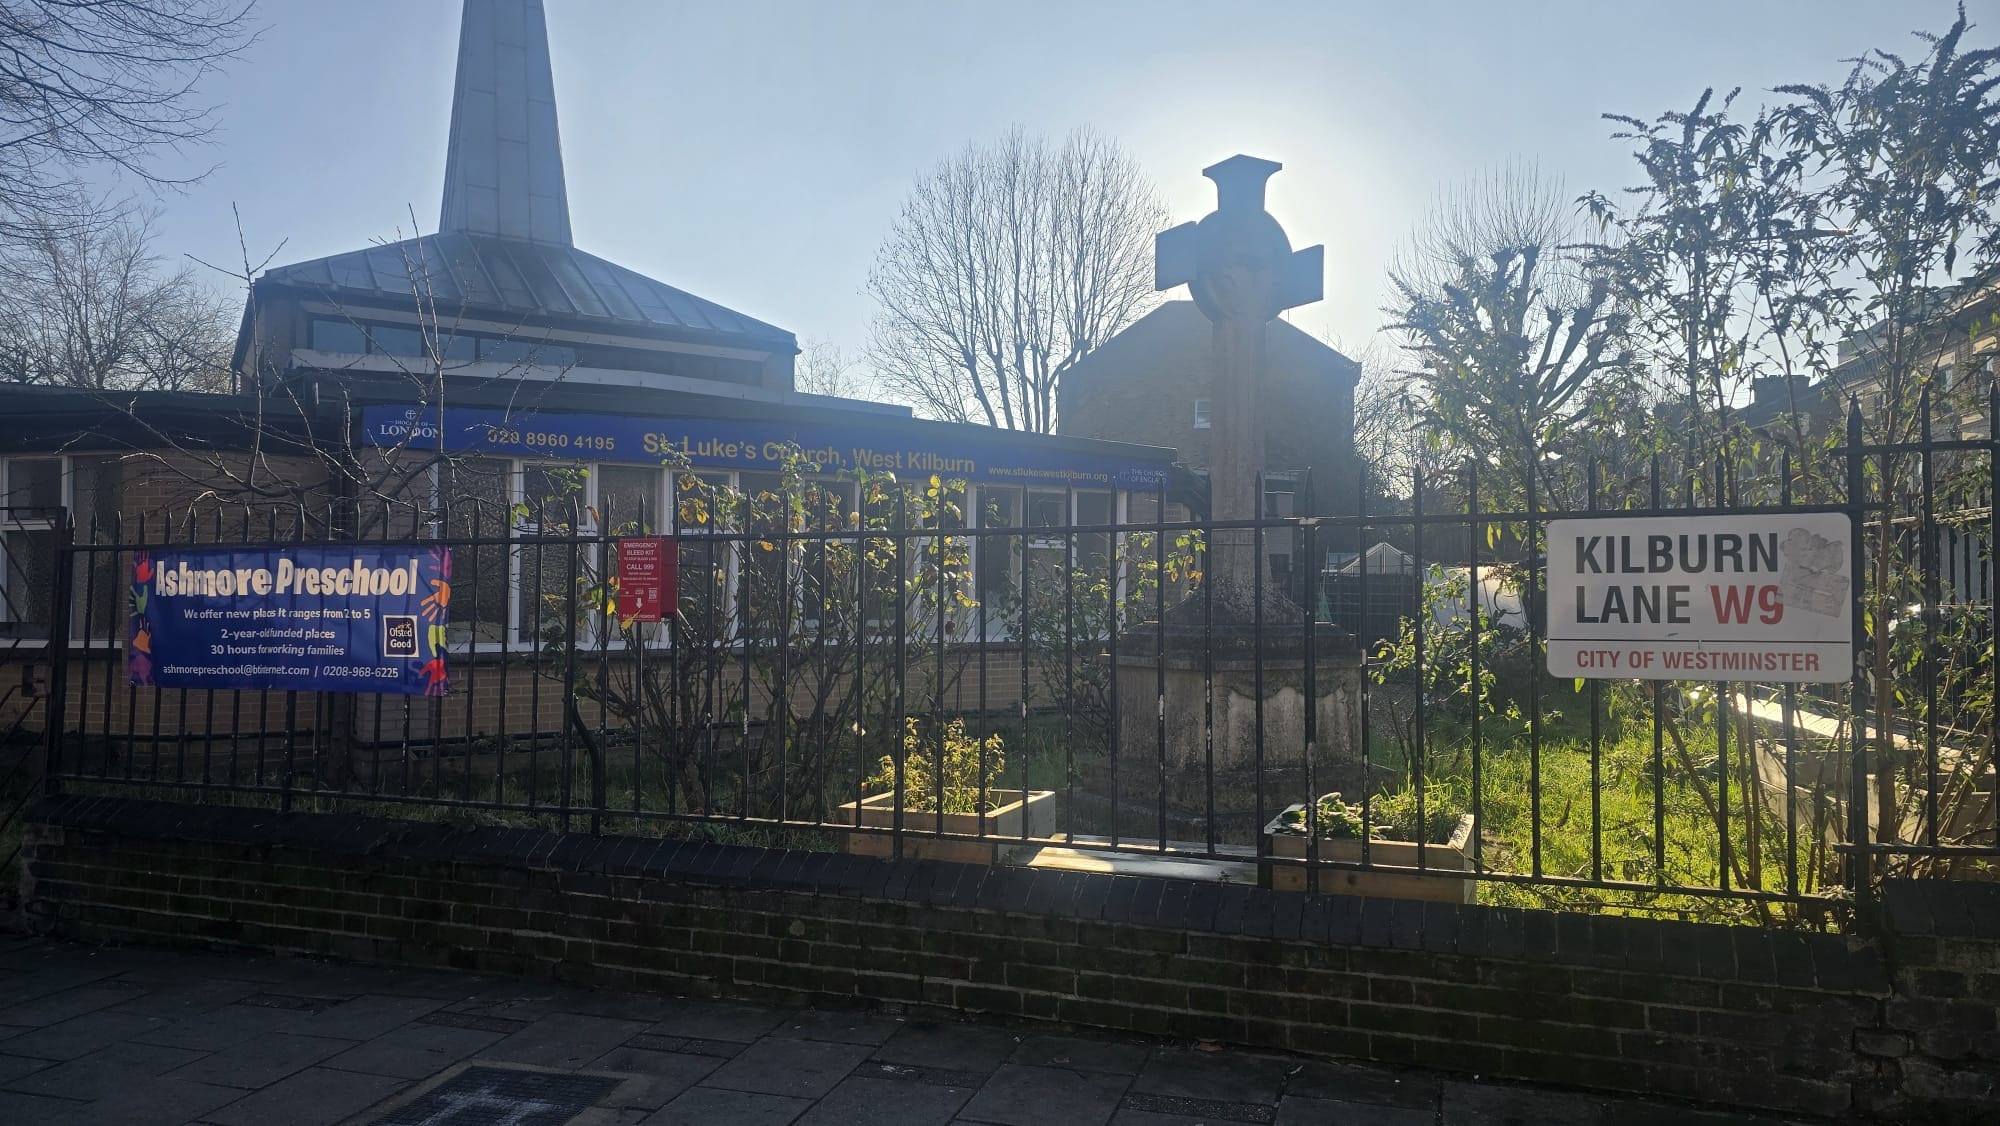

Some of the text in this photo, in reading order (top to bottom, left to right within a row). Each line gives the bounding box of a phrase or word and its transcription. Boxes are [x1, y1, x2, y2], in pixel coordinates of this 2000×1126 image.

[526, 432, 568, 448] 8960
[574, 435, 615, 450] 4195
[683, 435, 757, 460] Luke's
[853, 448, 903, 469] West
[908, 451, 975, 473] Kilburn
[1575, 532, 1779, 574] KILBURN
[155, 558, 418, 597] Ashmore Preschool
[1576, 584, 1784, 625] LANE W9
[183, 608, 198, 619] We
[199, 608, 224, 619] offer
[226, 610, 250, 619] new
[289, 609, 321, 620] ranges
[322, 607, 344, 619] from
[344, 608, 350, 619] 2
[351, 609, 362, 619] to
[364, 608, 371, 619] 5
[305, 628, 336, 641] places
[389, 627, 412, 637] Ofsted
[210, 644, 224, 655] 30
[227, 644, 257, 655] hours
[307, 645, 345, 656] families
[390, 639, 412, 648] Good
[1576, 650, 1820, 672] CITY OF WESTMINSTER
[322, 665, 399, 678] 0208-968-6225
